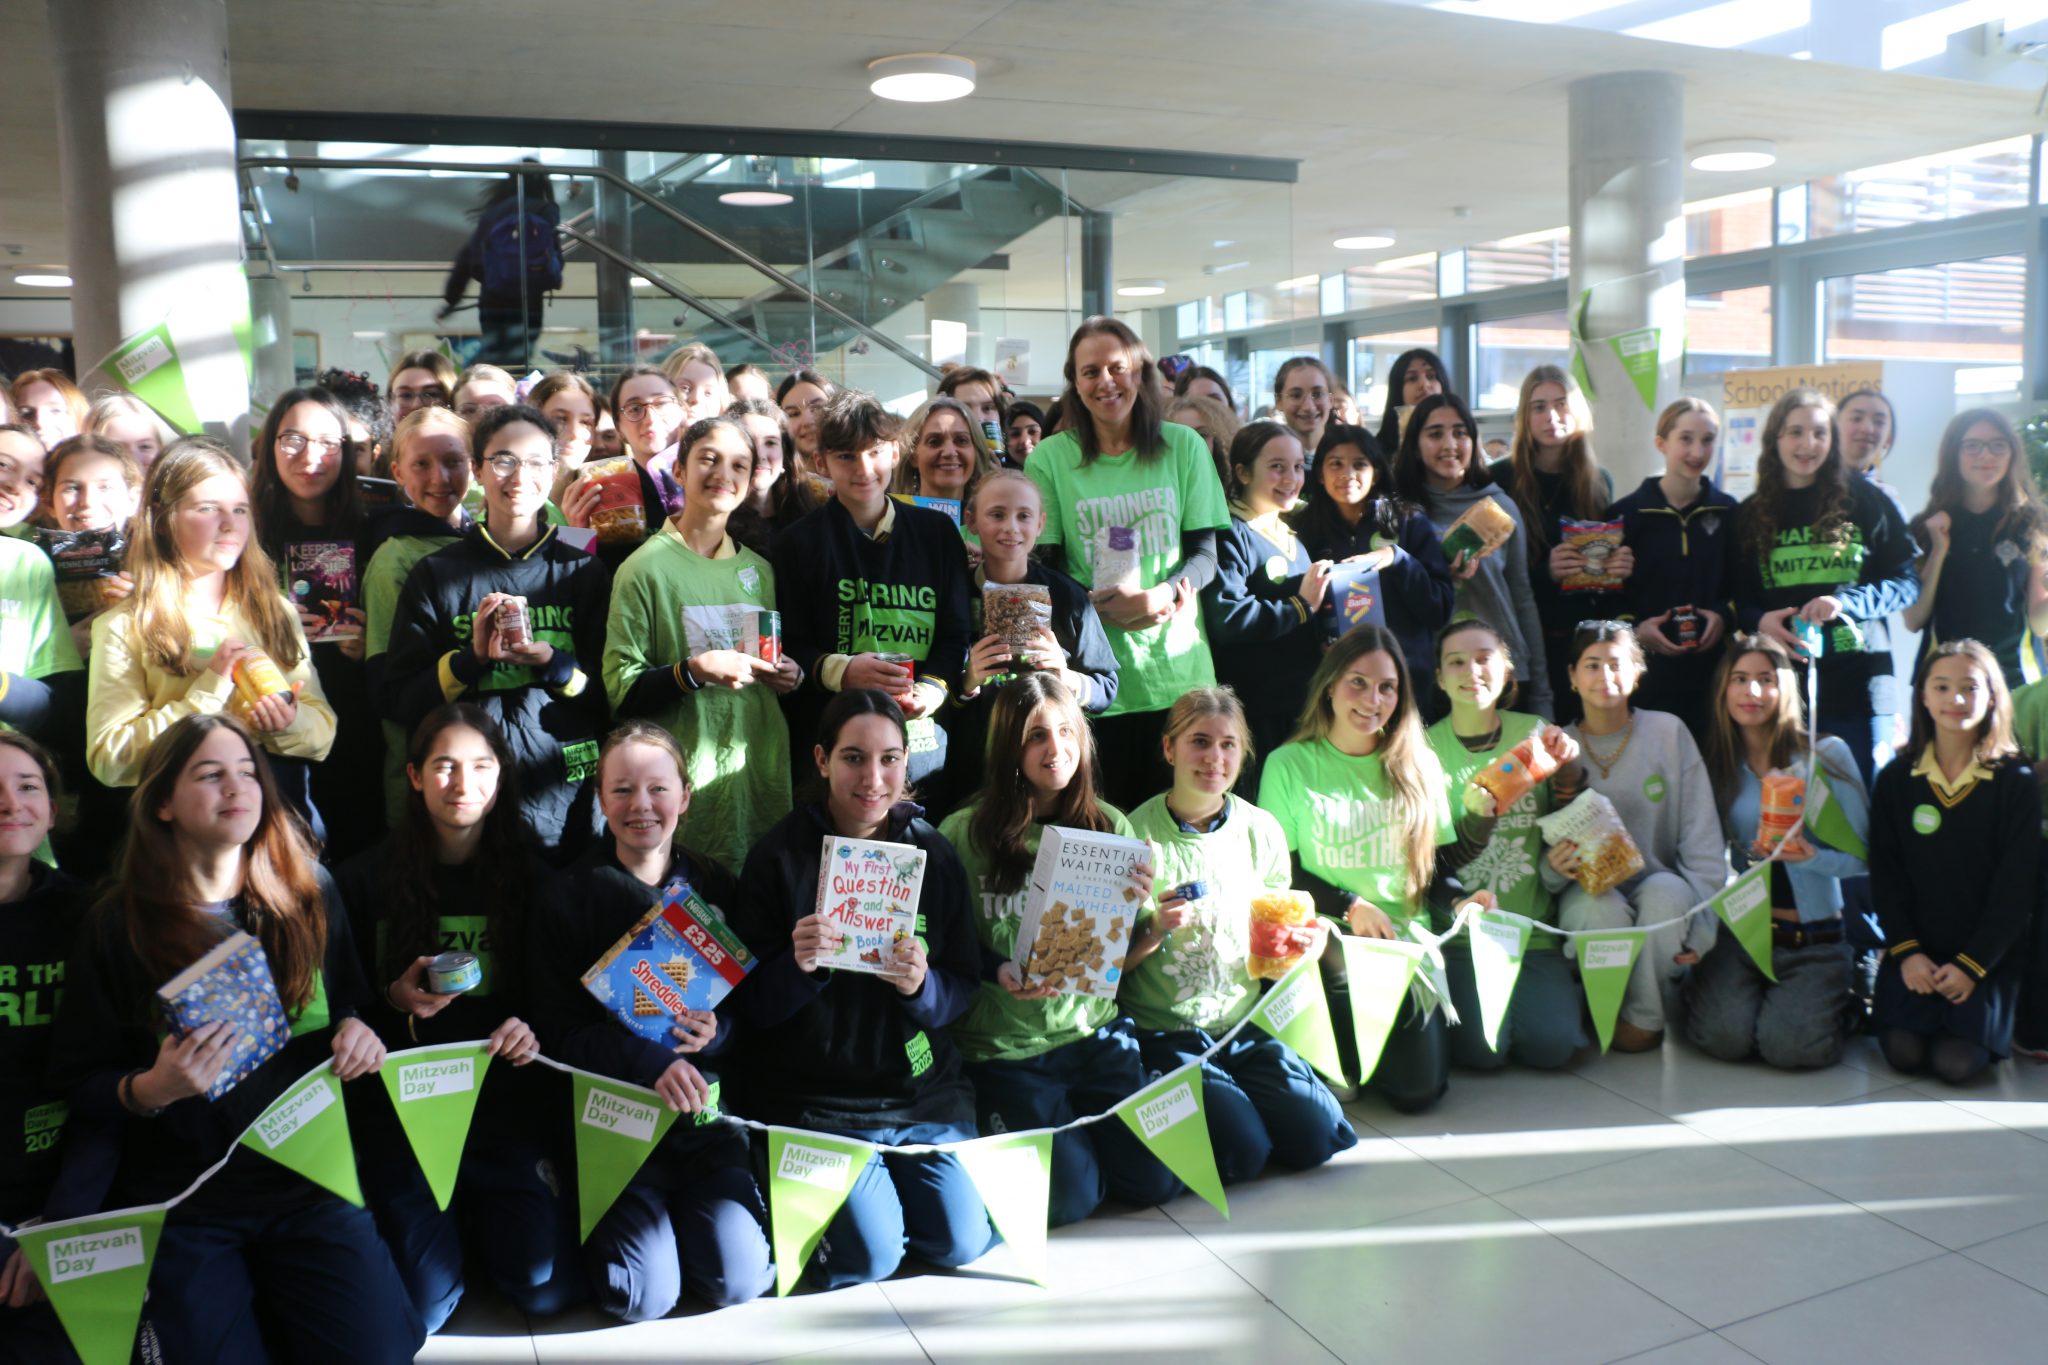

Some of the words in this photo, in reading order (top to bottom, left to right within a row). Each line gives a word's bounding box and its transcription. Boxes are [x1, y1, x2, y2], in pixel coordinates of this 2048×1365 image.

[119, 339, 162, 370] Mitzvah
[126, 360, 147, 378] Day
[1723, 377, 1791, 404] School
[1075, 487, 1177, 535] STRONGER
[844, 861, 860, 879] My
[863, 861, 892, 875] First
[833, 875, 911, 902] Question
[1053, 880, 1113, 900] MALTED
[863, 898, 884, 912] and
[1075, 899, 1136, 917] WHEATS
[828, 902, 893, 933] Answer
[682, 923, 726, 966] £3.25
[856, 934, 884, 949] Book
[631, 959, 689, 1016] Shreddies
[1273, 1005, 1295, 1026] Day
[404, 1062, 470, 1082] Mitzvah
[404, 1081, 436, 1096] Day
[259, 1083, 325, 1134] Mitzvah
[591, 1093, 653, 1123] Mitzvah
[1140, 1087, 1190, 1121] Mitzvah
[587, 1105, 618, 1128] Day
[1146, 1113, 1169, 1133] Day
[267, 1116, 299, 1142] Day
[781, 1160, 812, 1178] Day
[786, 1147, 846, 1169] Mitzvah
[53, 1232, 137, 1259] Mitzvah
[55, 1256, 96, 1275] Day
